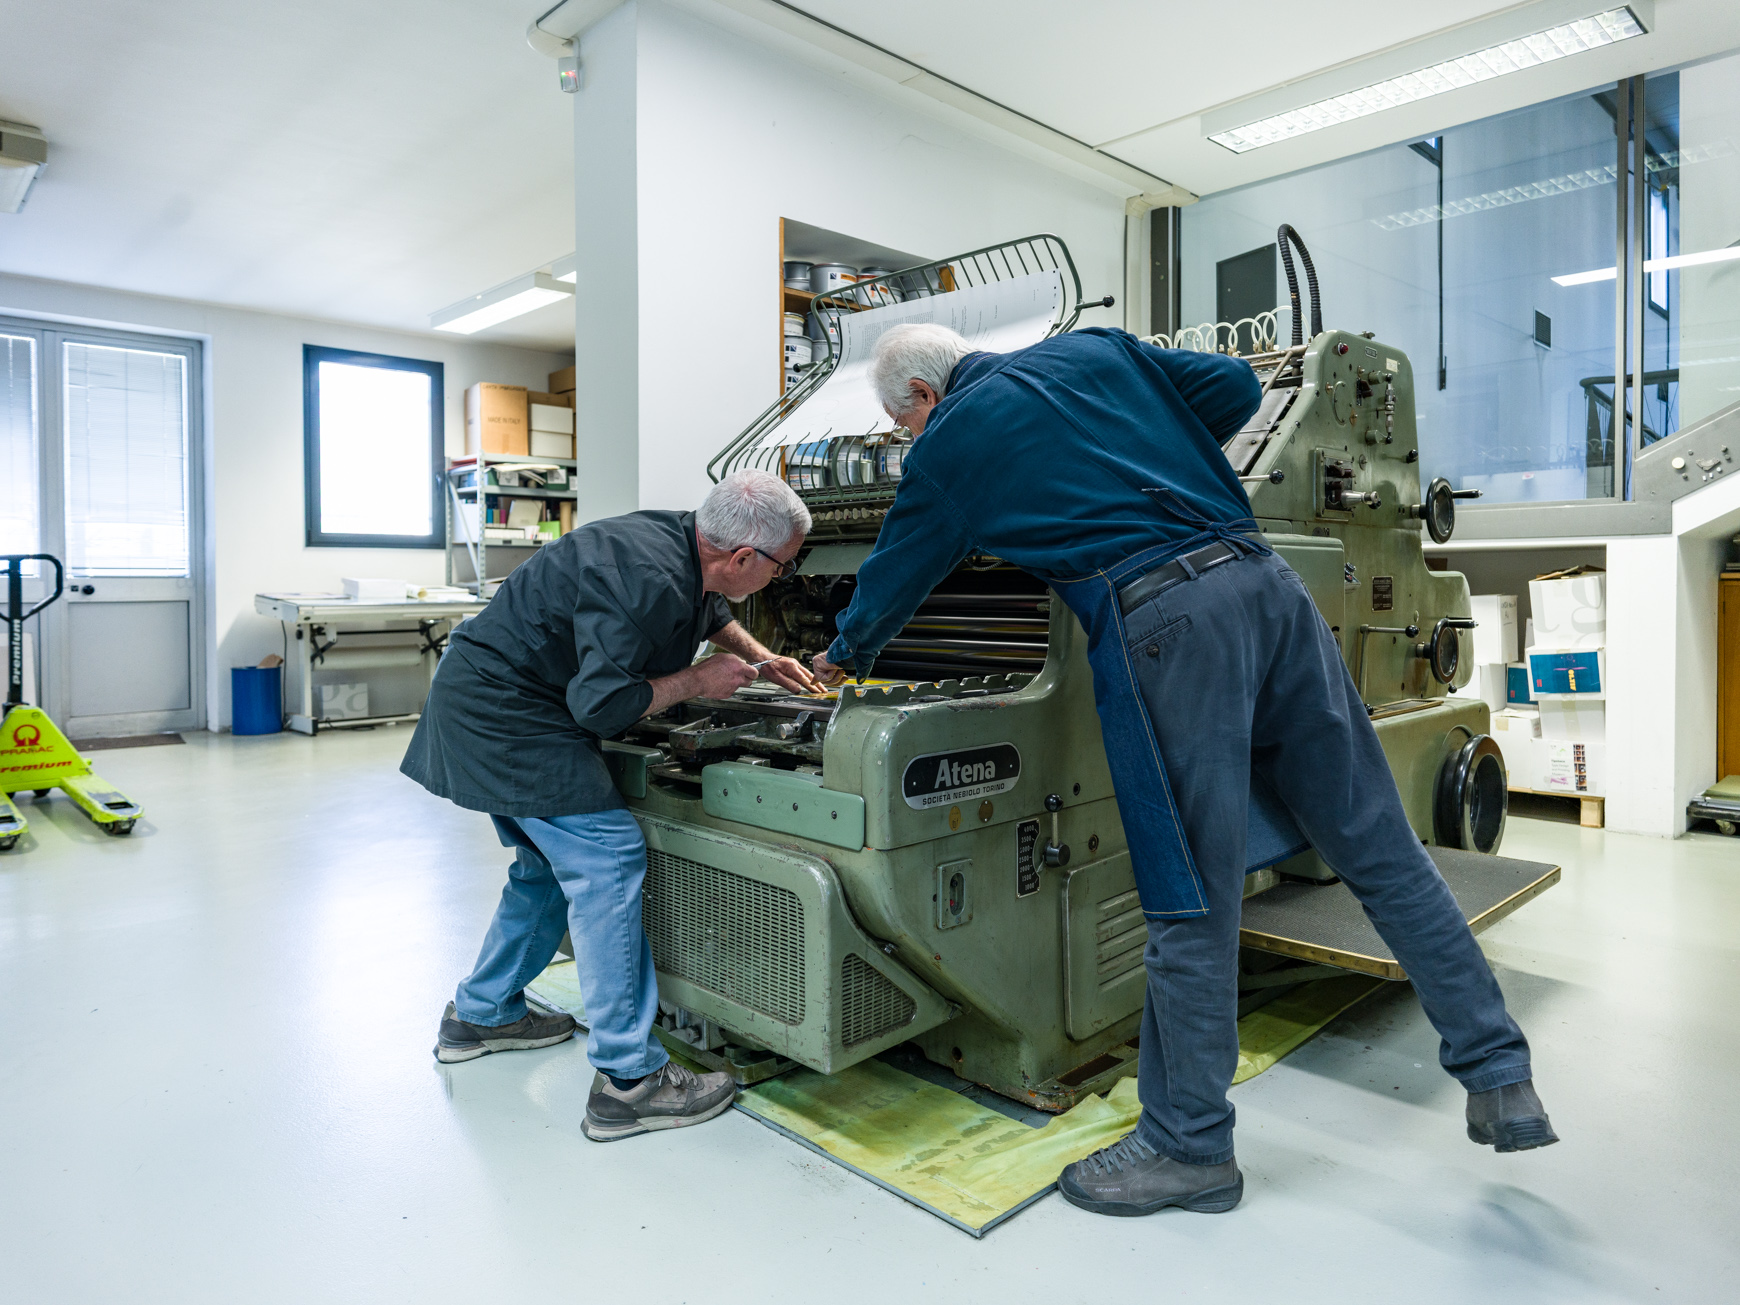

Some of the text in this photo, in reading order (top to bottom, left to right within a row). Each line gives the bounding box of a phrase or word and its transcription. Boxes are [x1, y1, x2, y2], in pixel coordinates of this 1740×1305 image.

[0, 745, 54, 756] PRAMAC
[0, 760, 73, 773] remium
[934, 759, 996, 789] Atena
[953, 788, 981, 800] NEBIOLO
[983, 782, 1005, 794] TORINO
[1021, 835, 1032, 844] 3500
